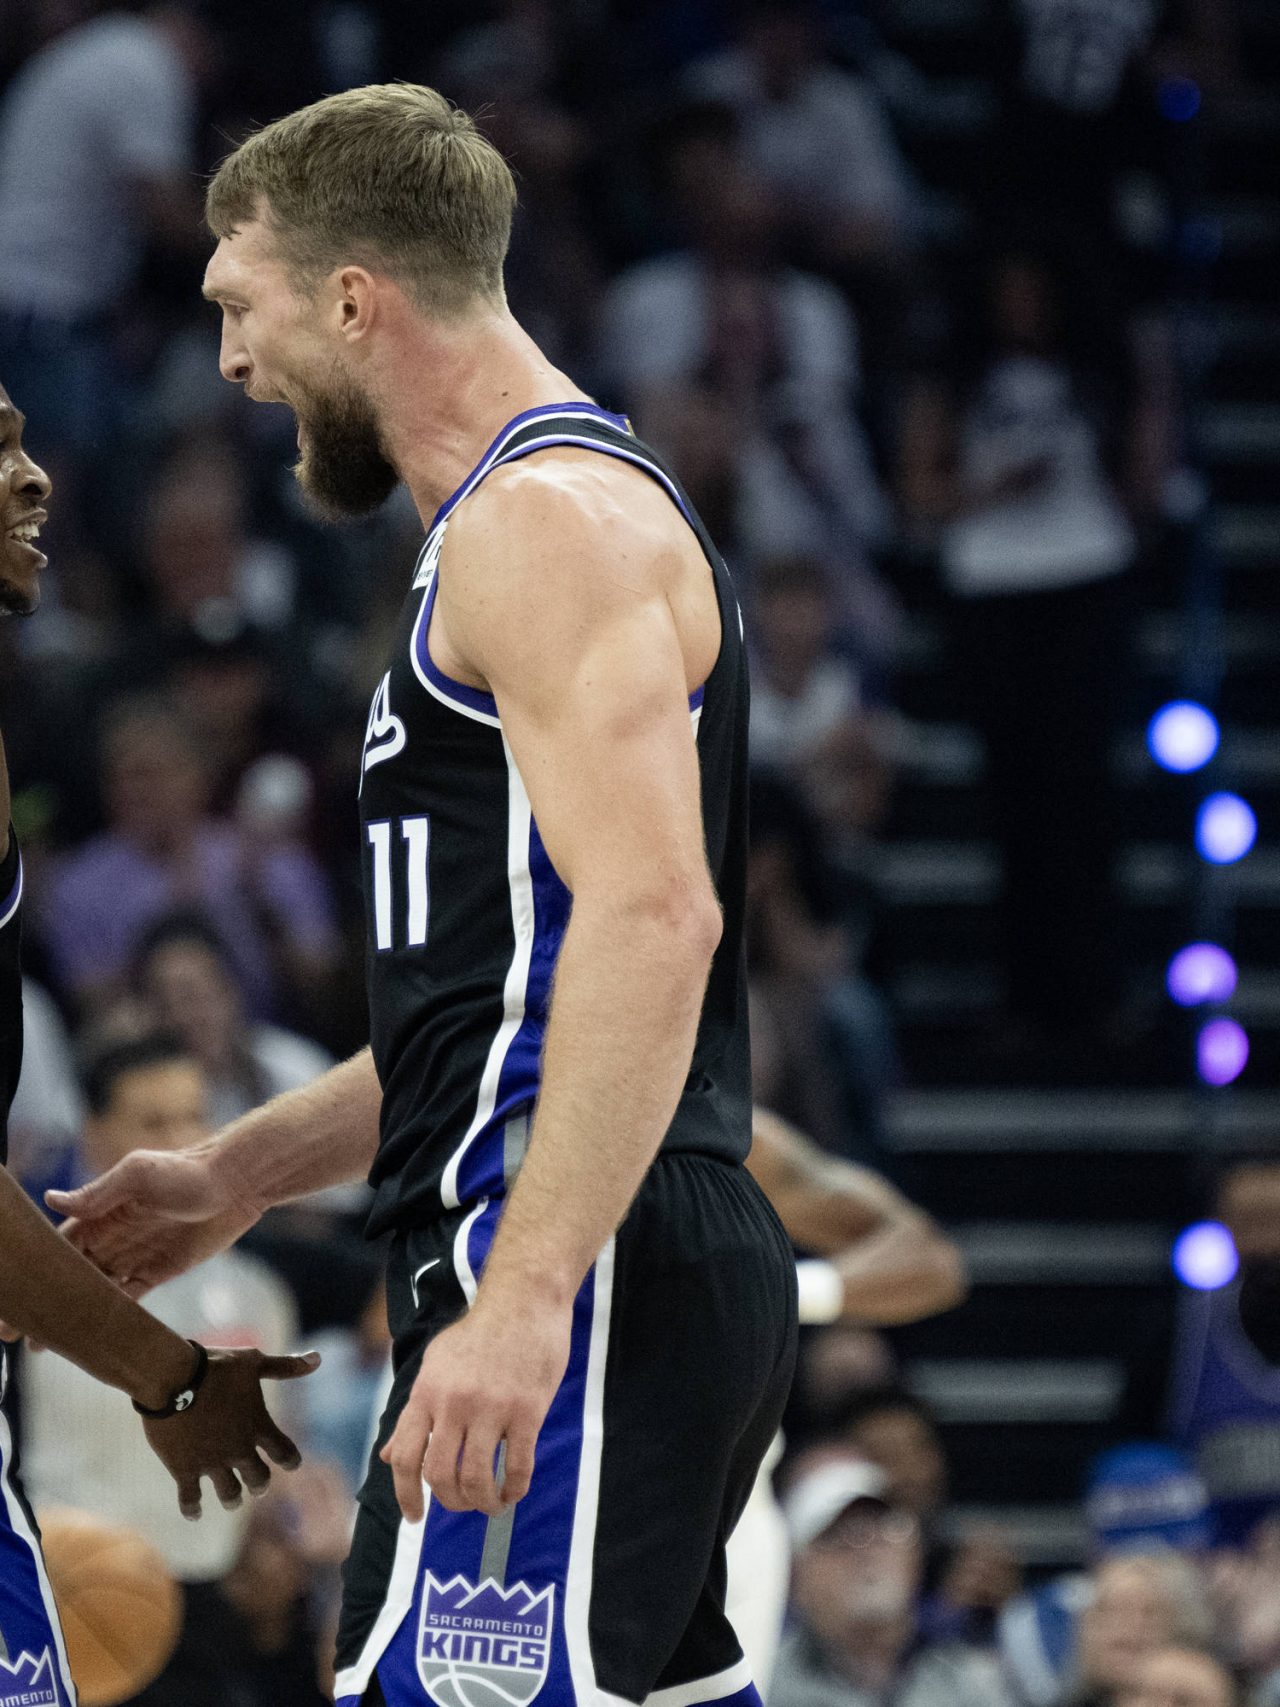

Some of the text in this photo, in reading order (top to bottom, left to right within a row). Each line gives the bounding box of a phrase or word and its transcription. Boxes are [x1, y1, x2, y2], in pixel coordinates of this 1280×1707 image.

[364, 813, 430, 952] 11
[429, 1613, 544, 1637] SACRAMENTO
[421, 1631, 547, 1671] KINGS
